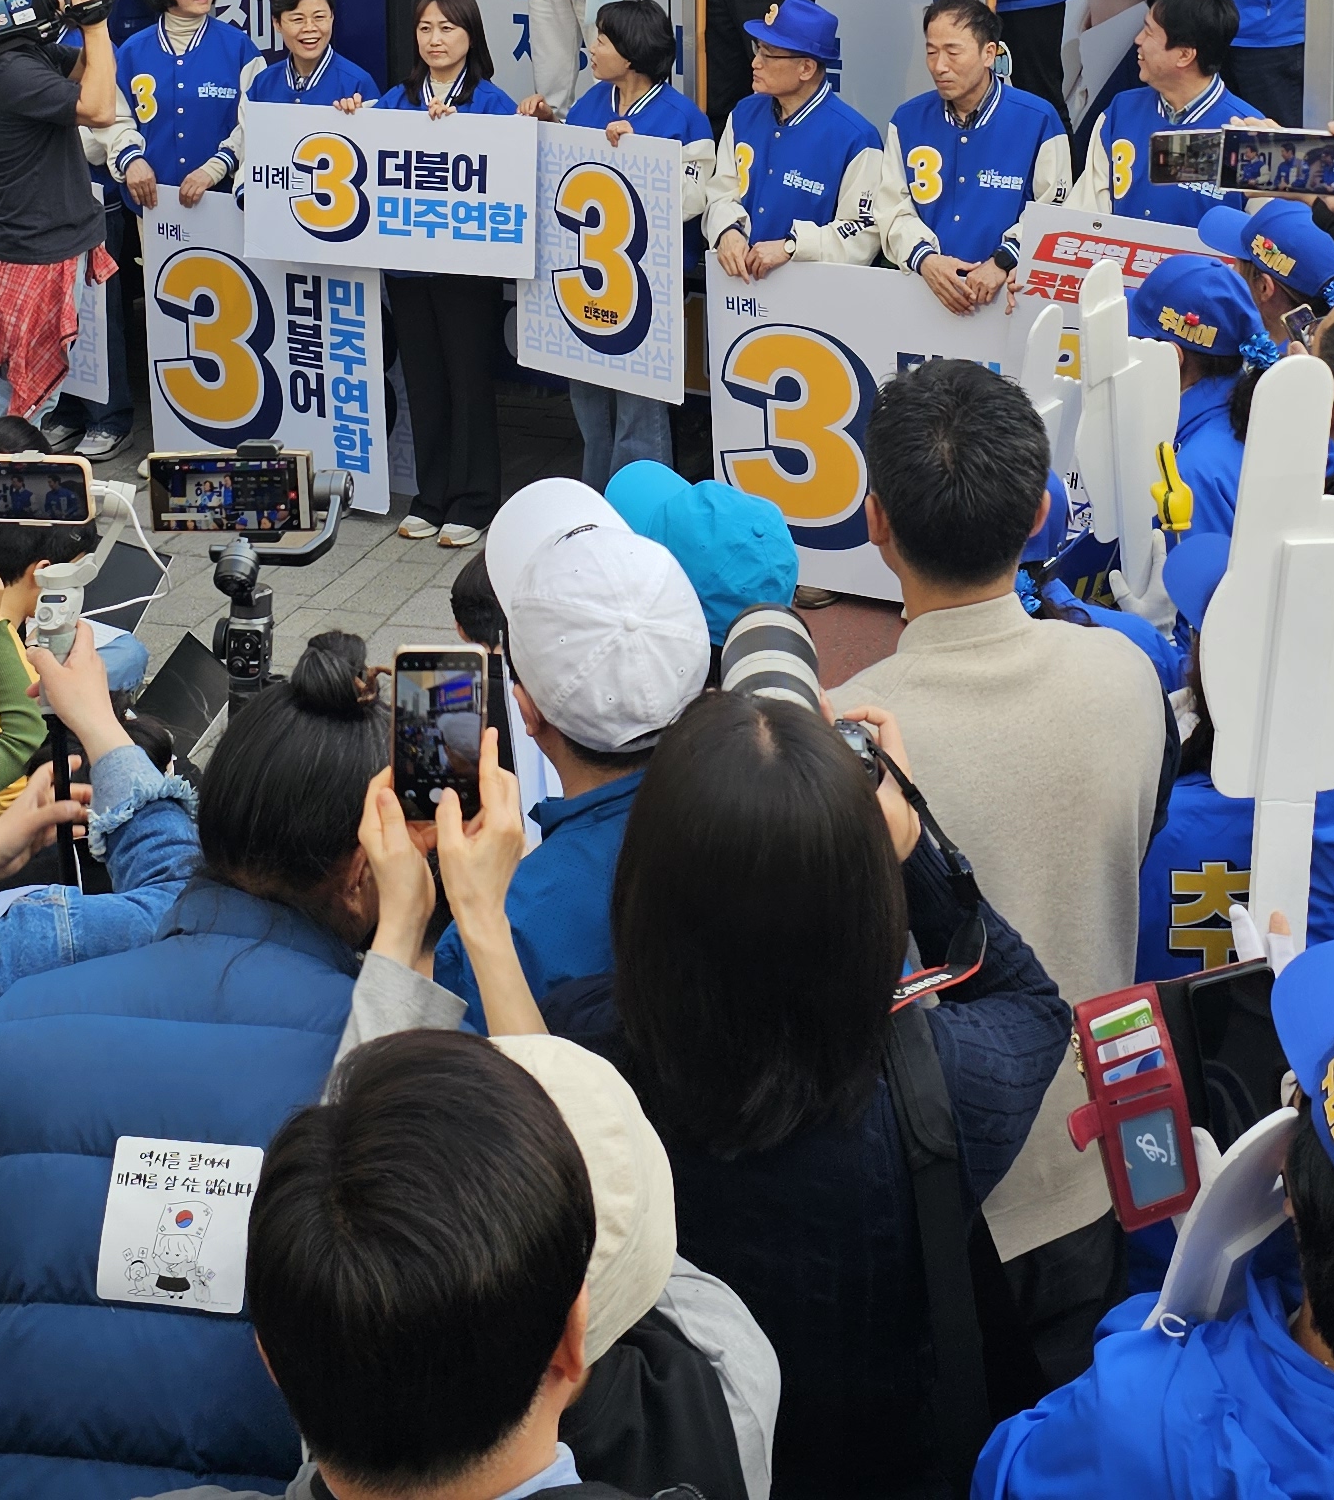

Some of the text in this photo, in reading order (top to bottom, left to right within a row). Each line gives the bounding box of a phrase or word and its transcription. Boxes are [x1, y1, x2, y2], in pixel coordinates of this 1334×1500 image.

[130, 73, 158, 124] 3
[252, 131, 371, 243] 비례는 3
[377, 149, 488, 195] 더불어
[782, 171, 825, 196] 민주연합
[906, 145, 943, 205] 3
[978, 173, 1024, 191] 민주연합
[1111, 138, 1136, 200] 3
[157, 221, 191, 243] 비례는
[376, 195, 528, 245] 민주연합
[551, 161, 653, 356] 3
[725, 295, 769, 318] 비례는
[1022, 268, 1083, 305] 못참
[583, 304, 619, 326] 민주연합
[154, 246, 284, 450] 3
[285, 272, 327, 419] 더불어
[327, 277, 373, 475] 민주연합
[720, 323, 879, 551] 3
[116, 1171, 255, 1198] 미래를 살 수는 없습니다
[139, 1150, 231, 1171] 역사를 팔아서
